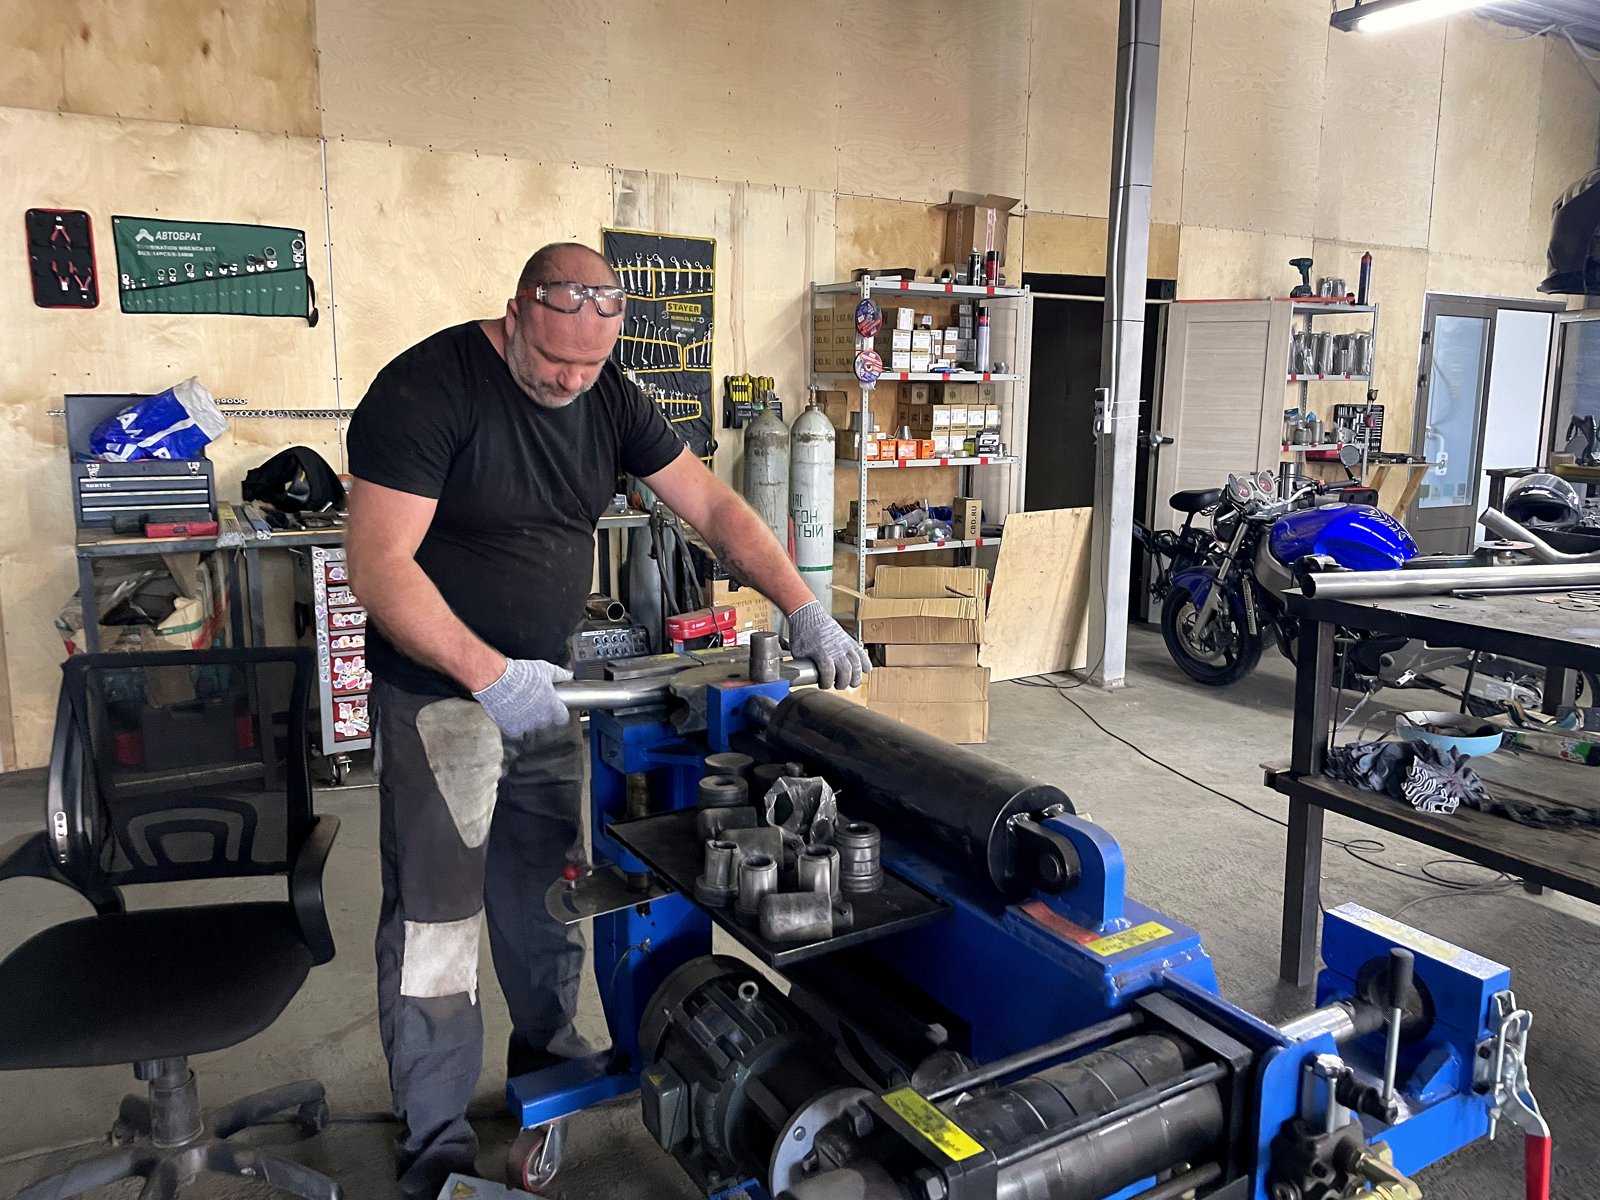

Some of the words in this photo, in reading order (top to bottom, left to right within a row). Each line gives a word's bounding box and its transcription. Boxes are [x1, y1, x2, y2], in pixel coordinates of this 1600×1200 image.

[155, 231, 202, 241] АВТОБРАТ
[667, 303, 699, 313] STAYER
[793, 510, 817, 523] ГОН
[970, 505, 978, 535] CBD.RU
[796, 525, 823, 537] ТЫЙ
